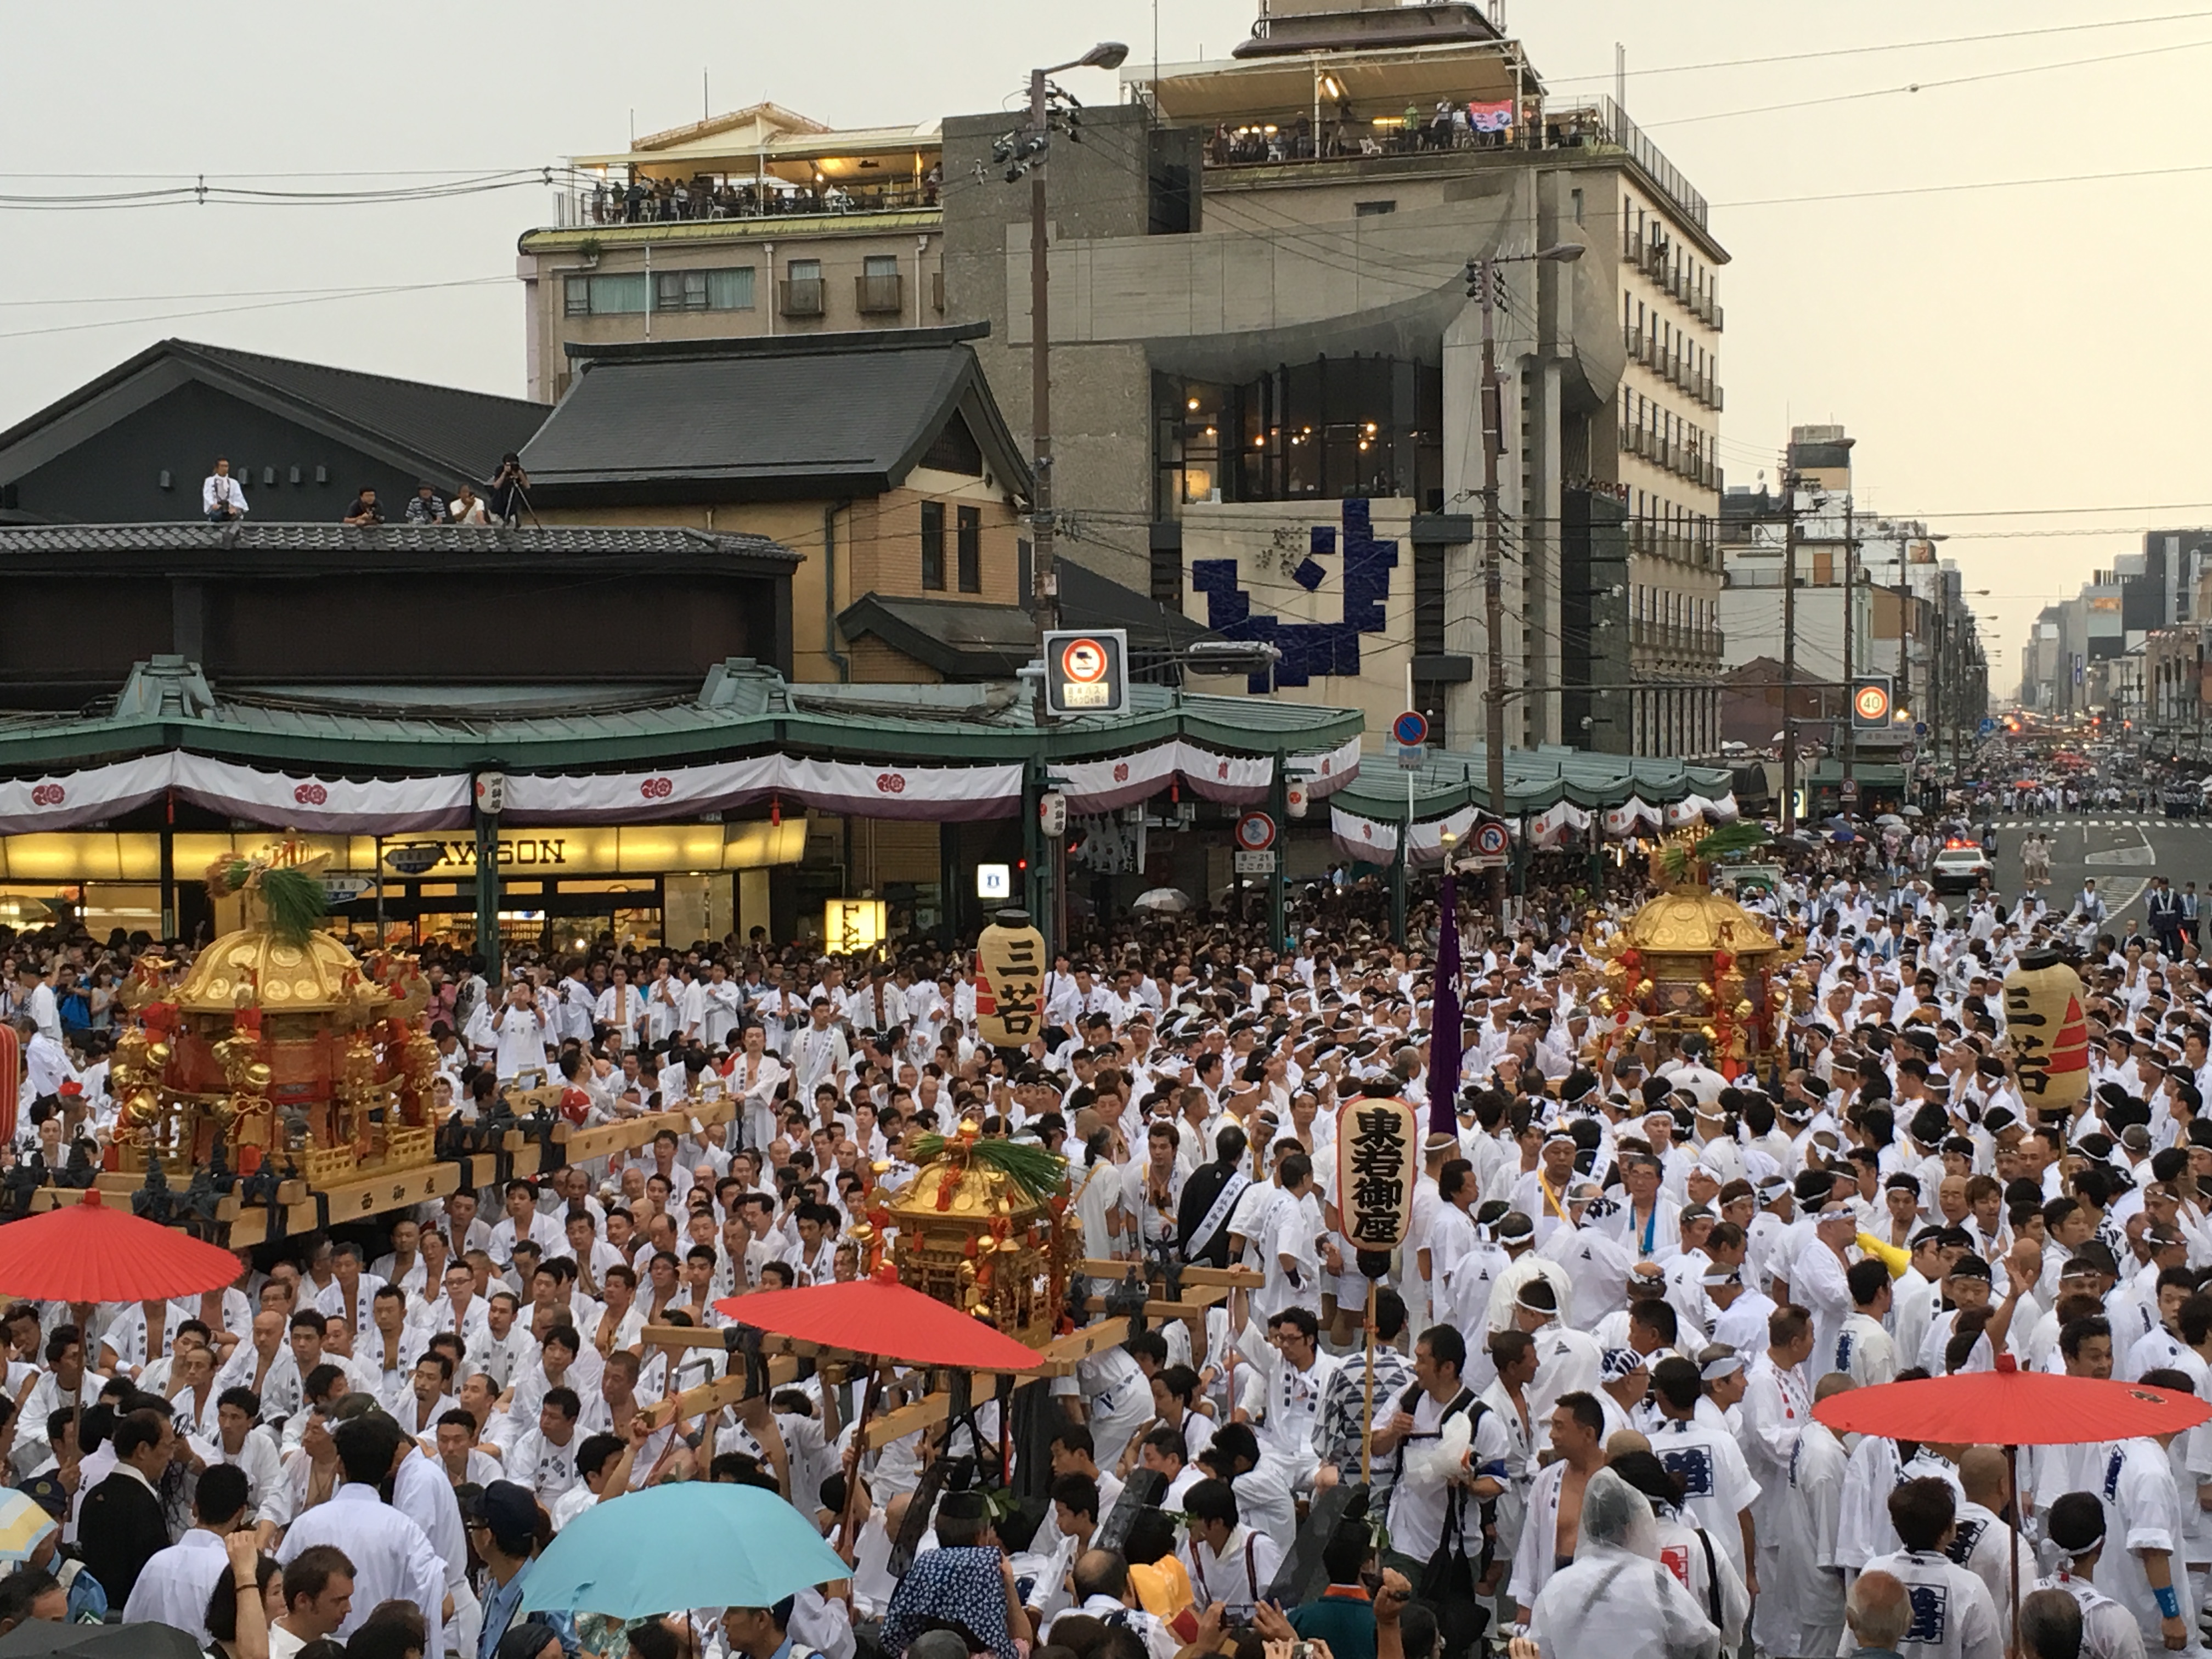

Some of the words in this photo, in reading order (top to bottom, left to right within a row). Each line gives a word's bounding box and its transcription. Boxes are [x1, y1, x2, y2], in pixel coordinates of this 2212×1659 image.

[1864, 697, 1880, 709] 40
[436, 839, 566, 866] AWSON
[992, 939, 1040, 1035] 三若
